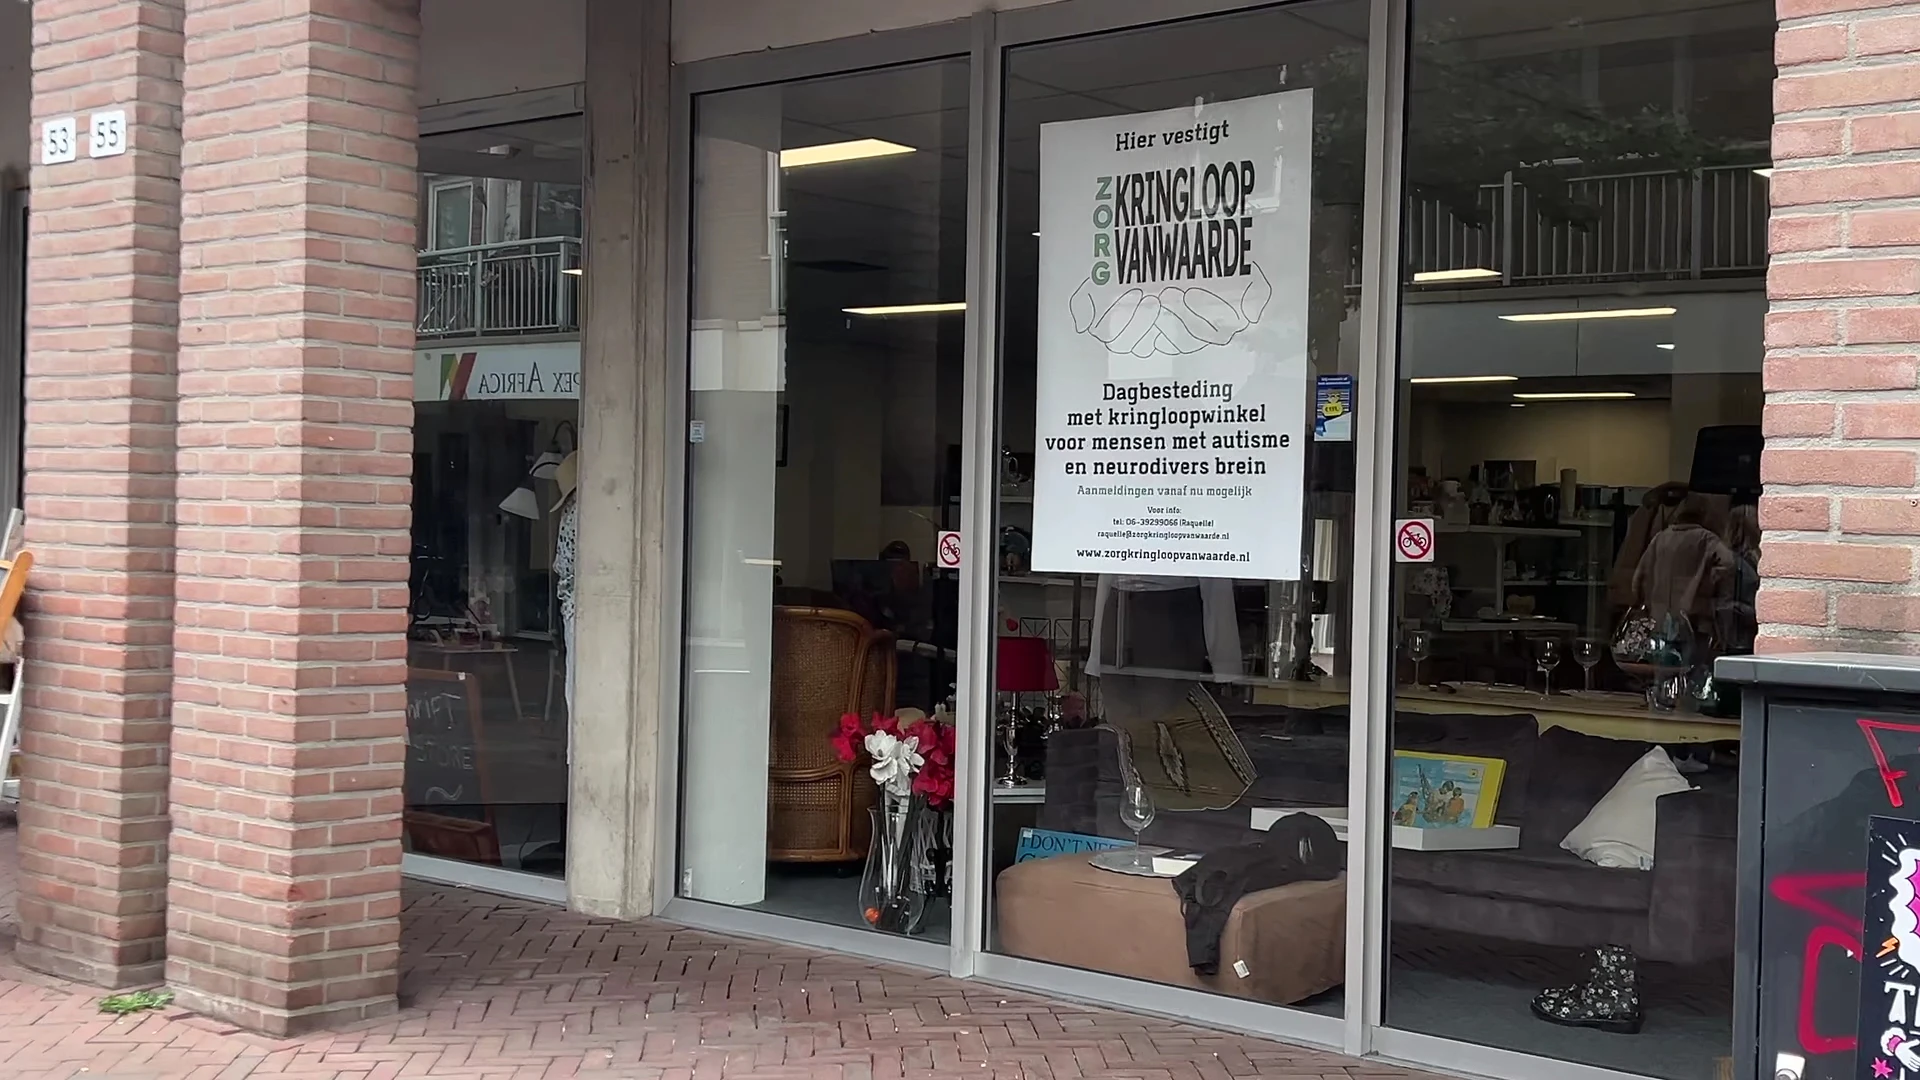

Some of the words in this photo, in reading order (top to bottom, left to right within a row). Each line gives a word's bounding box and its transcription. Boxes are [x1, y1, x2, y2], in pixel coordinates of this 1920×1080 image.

[49, 127, 69, 155] 53
[96, 120, 118, 149] 55
[1115, 132, 1156, 152] Hier
[1162, 119, 1230, 146] vestigt
[1113, 159, 1256, 228] KRINGLOOP
[1091, 175, 1113, 287] ZORG
[1113, 216, 1253, 285] VANWAARDE
[1102, 380, 1233, 405] Dagbesteding
[1067, 408, 1103, 426] met
[1108, 404, 1266, 430] kringloopwinkel
[1045, 437, 1086, 451] voor
[1091, 436, 1166, 450] mensen
[1172, 431, 1207, 449] met
[1212, 430, 1290, 449] autisme
[1065, 462, 1087, 475] en
[1092, 457, 1209, 475] neurodivers
[1215, 456, 1266, 475] brein
[1076, 485, 1154, 499] Aanmeldingen
[1157, 485, 1187, 497] vanaf
[1190, 488, 1203, 497] nu
[1206, 486, 1252, 499] mogelijk
[1147, 506, 1164, 514] Voor
[1165, 506, 1182, 514] info:
[1112, 518, 1125, 526] tel:
[1125, 518, 1179, 527] 06-39299066
[1097, 530, 1230, 541] raquelle@zorgkringloopvanwaarde.nl
[1076, 548, 1251, 562] www.zorgkringloopvanwaarde.nl
[1031, 834, 1083, 854] DON'T
